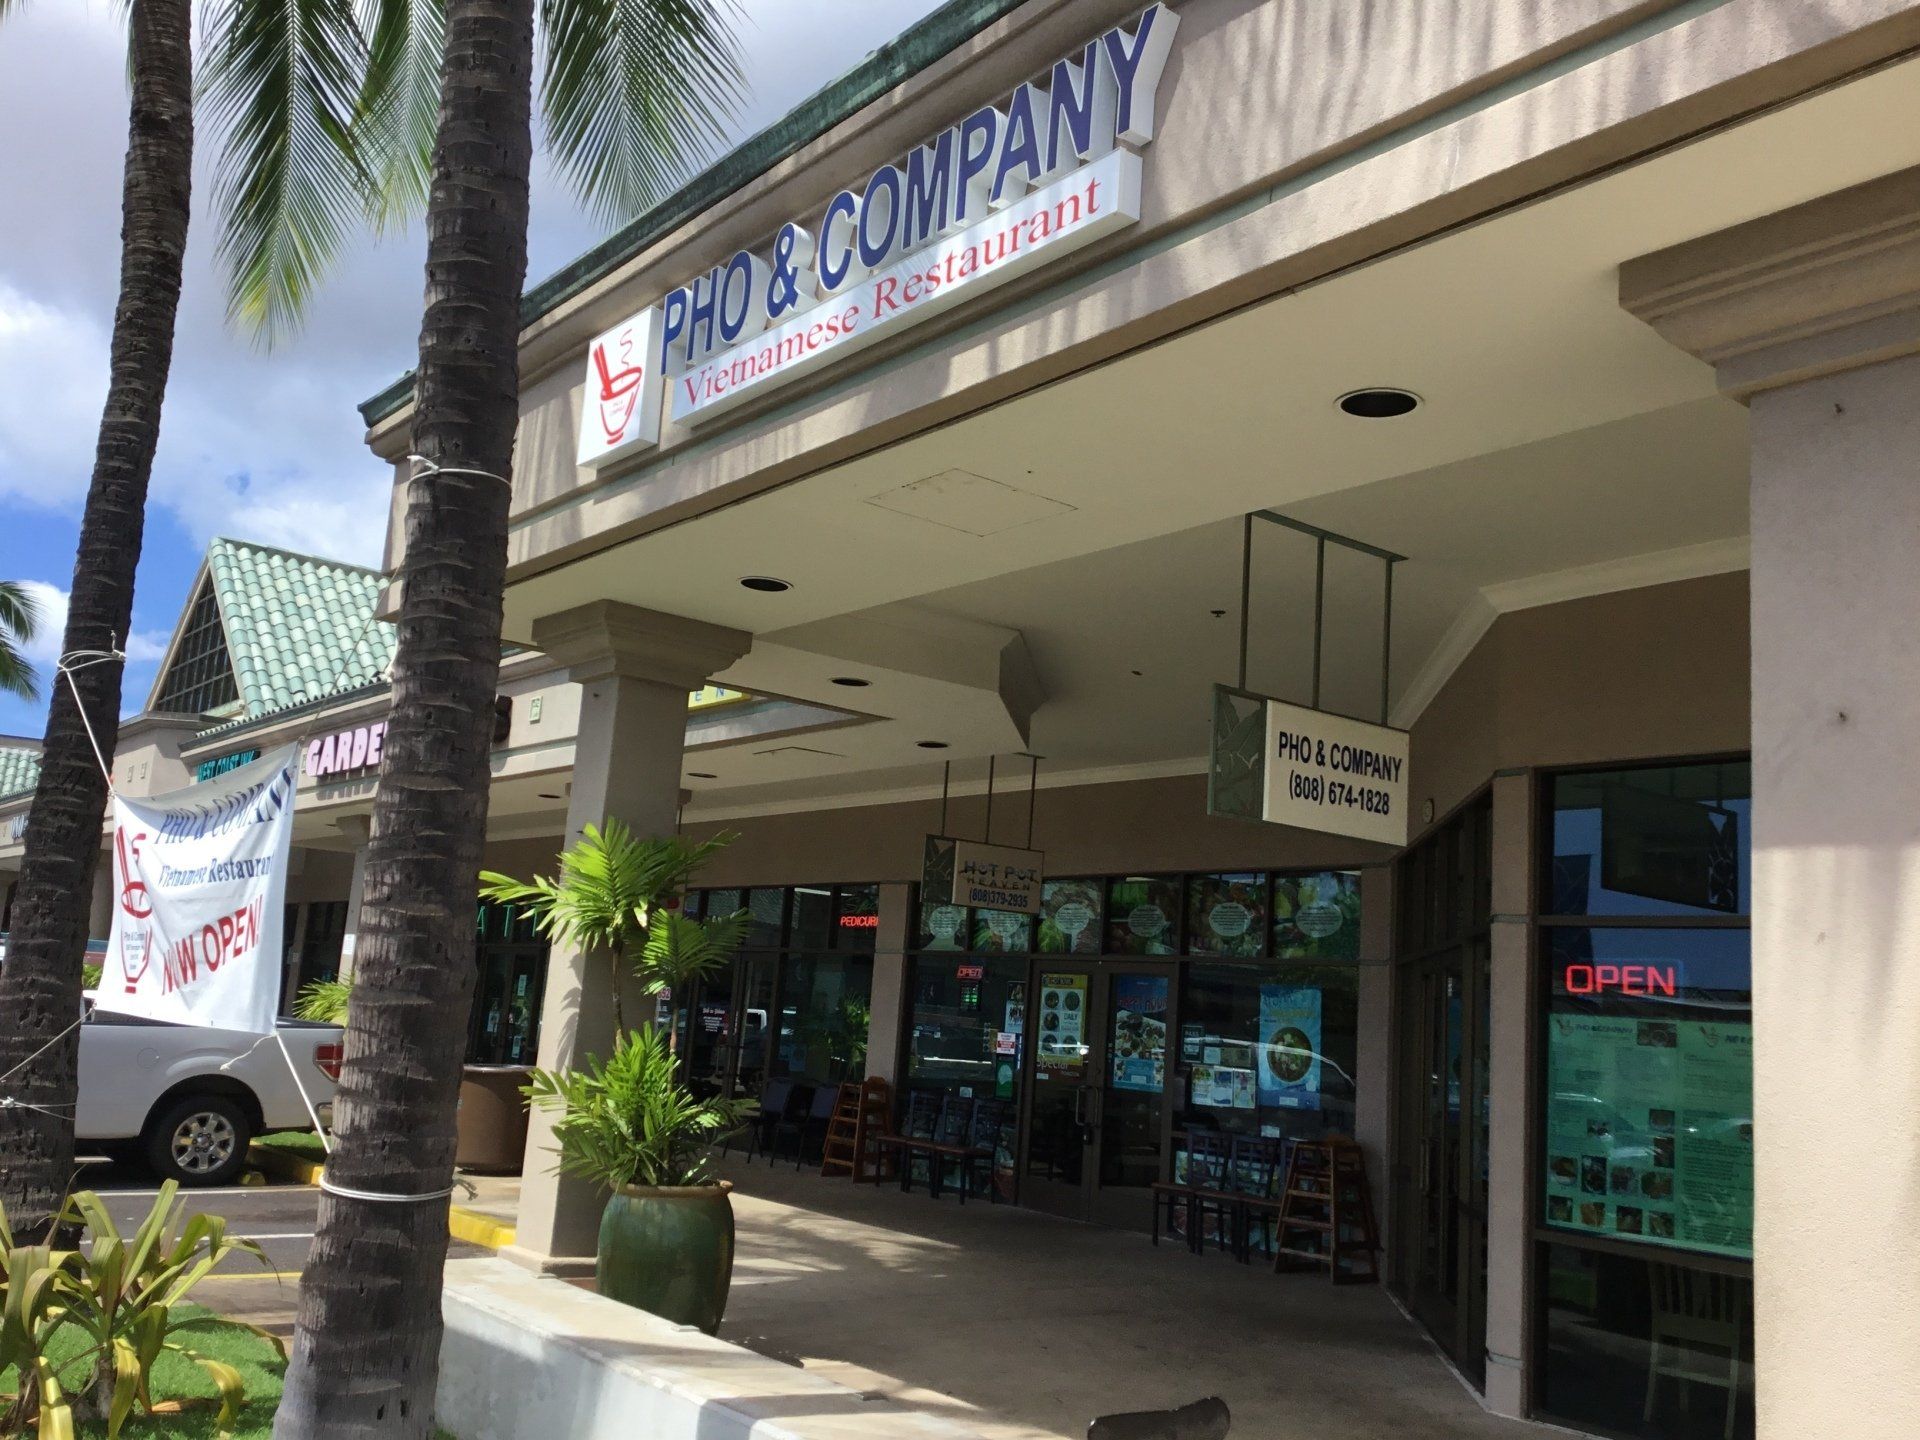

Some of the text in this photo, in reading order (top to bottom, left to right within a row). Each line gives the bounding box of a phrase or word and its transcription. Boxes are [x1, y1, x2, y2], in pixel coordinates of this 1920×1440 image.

[660, 2, 1165, 375] PHO & COMPANY
[683, 175, 1102, 407] Vietnamese Restaurant
[1278, 731, 1403, 784] PHO & COMPANY
[1289, 769, 1390, 815] (808) 674-1828
[154, 805, 197, 844] PHO
[158, 864, 208, 888] Vietnamese
[963, 860, 1038, 882] HOT POT
[202, 894, 263, 972] OPEN!
[958, 966, 983, 977] OPEN
[1565, 964, 1675, 996] OPEN
